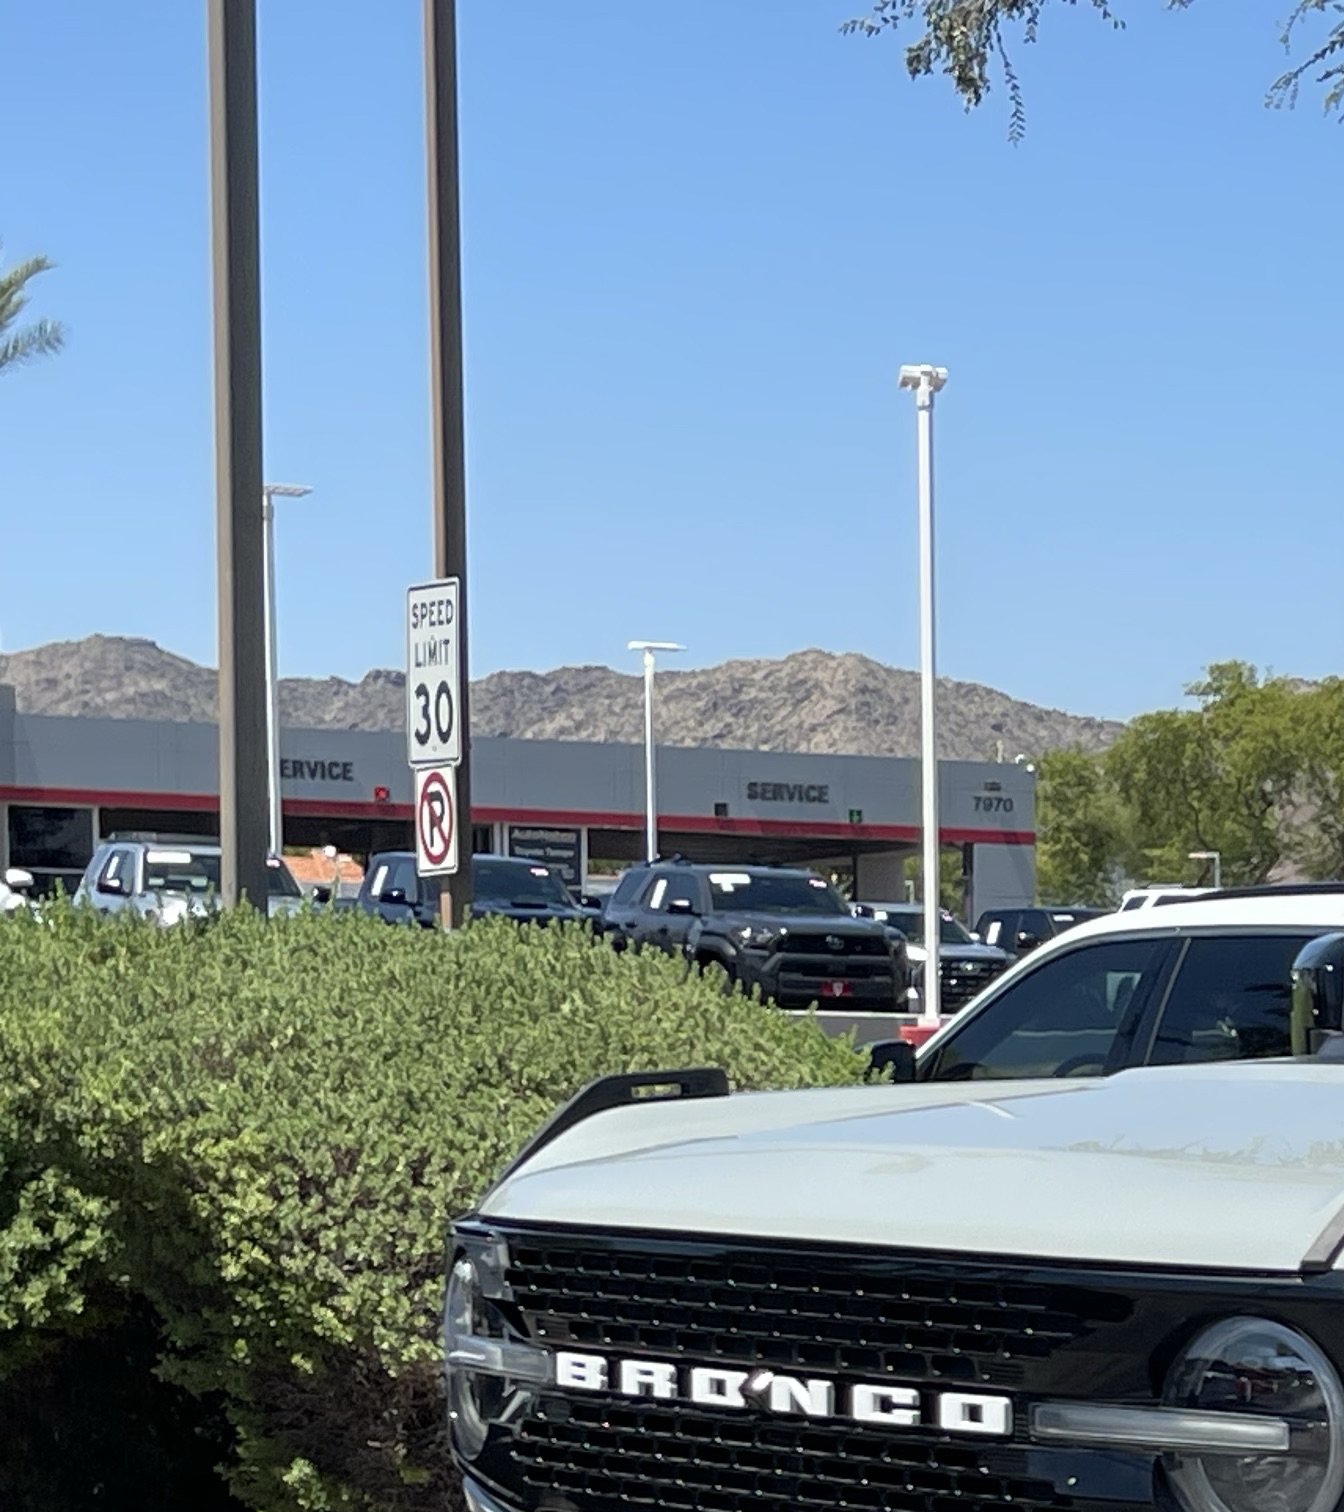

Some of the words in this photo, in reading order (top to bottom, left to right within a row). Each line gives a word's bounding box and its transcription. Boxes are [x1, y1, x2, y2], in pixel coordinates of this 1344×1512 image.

[412, 598, 453, 629] SPEED
[414, 639, 450, 668] LIMIT
[414, 680, 453, 745] 30
[280, 758, 354, 781] ERVICE
[747, 782, 829, 804] SERVICE
[974, 796, 1014, 813] 7970
[556, 1350, 1013, 1435] BRONCO
